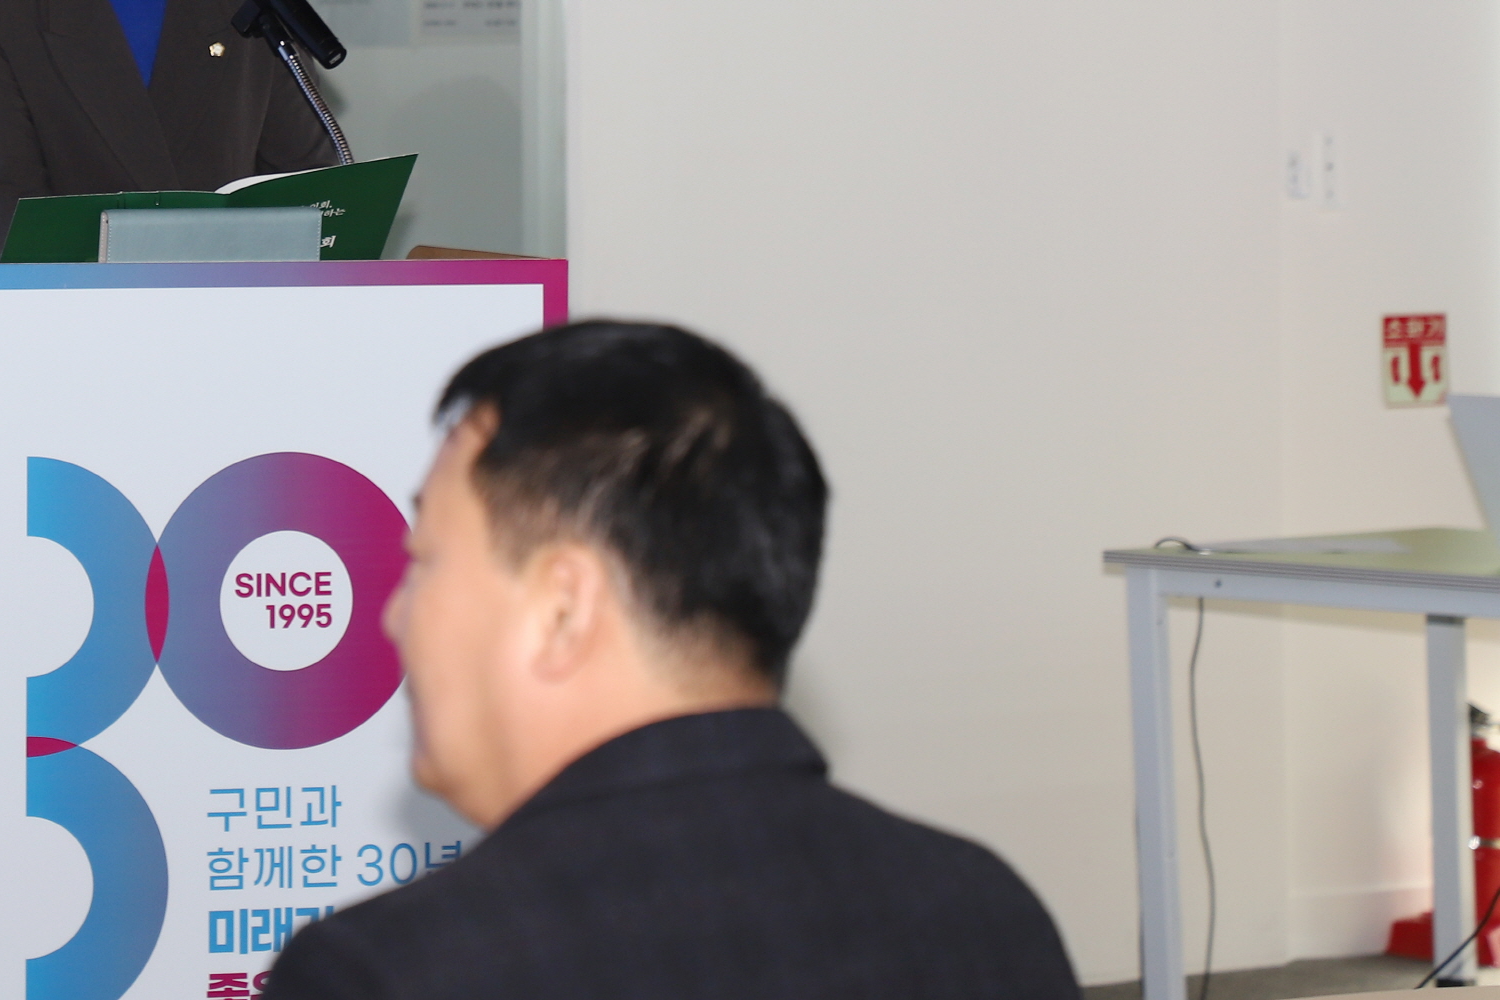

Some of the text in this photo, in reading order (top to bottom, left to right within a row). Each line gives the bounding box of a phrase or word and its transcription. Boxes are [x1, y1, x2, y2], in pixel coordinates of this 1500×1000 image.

[234, 571, 333, 599] SINCE
[265, 603, 333, 629] 1995
[206, 784, 342, 832] 구민과
[206, 843, 342, 891] 함께한
